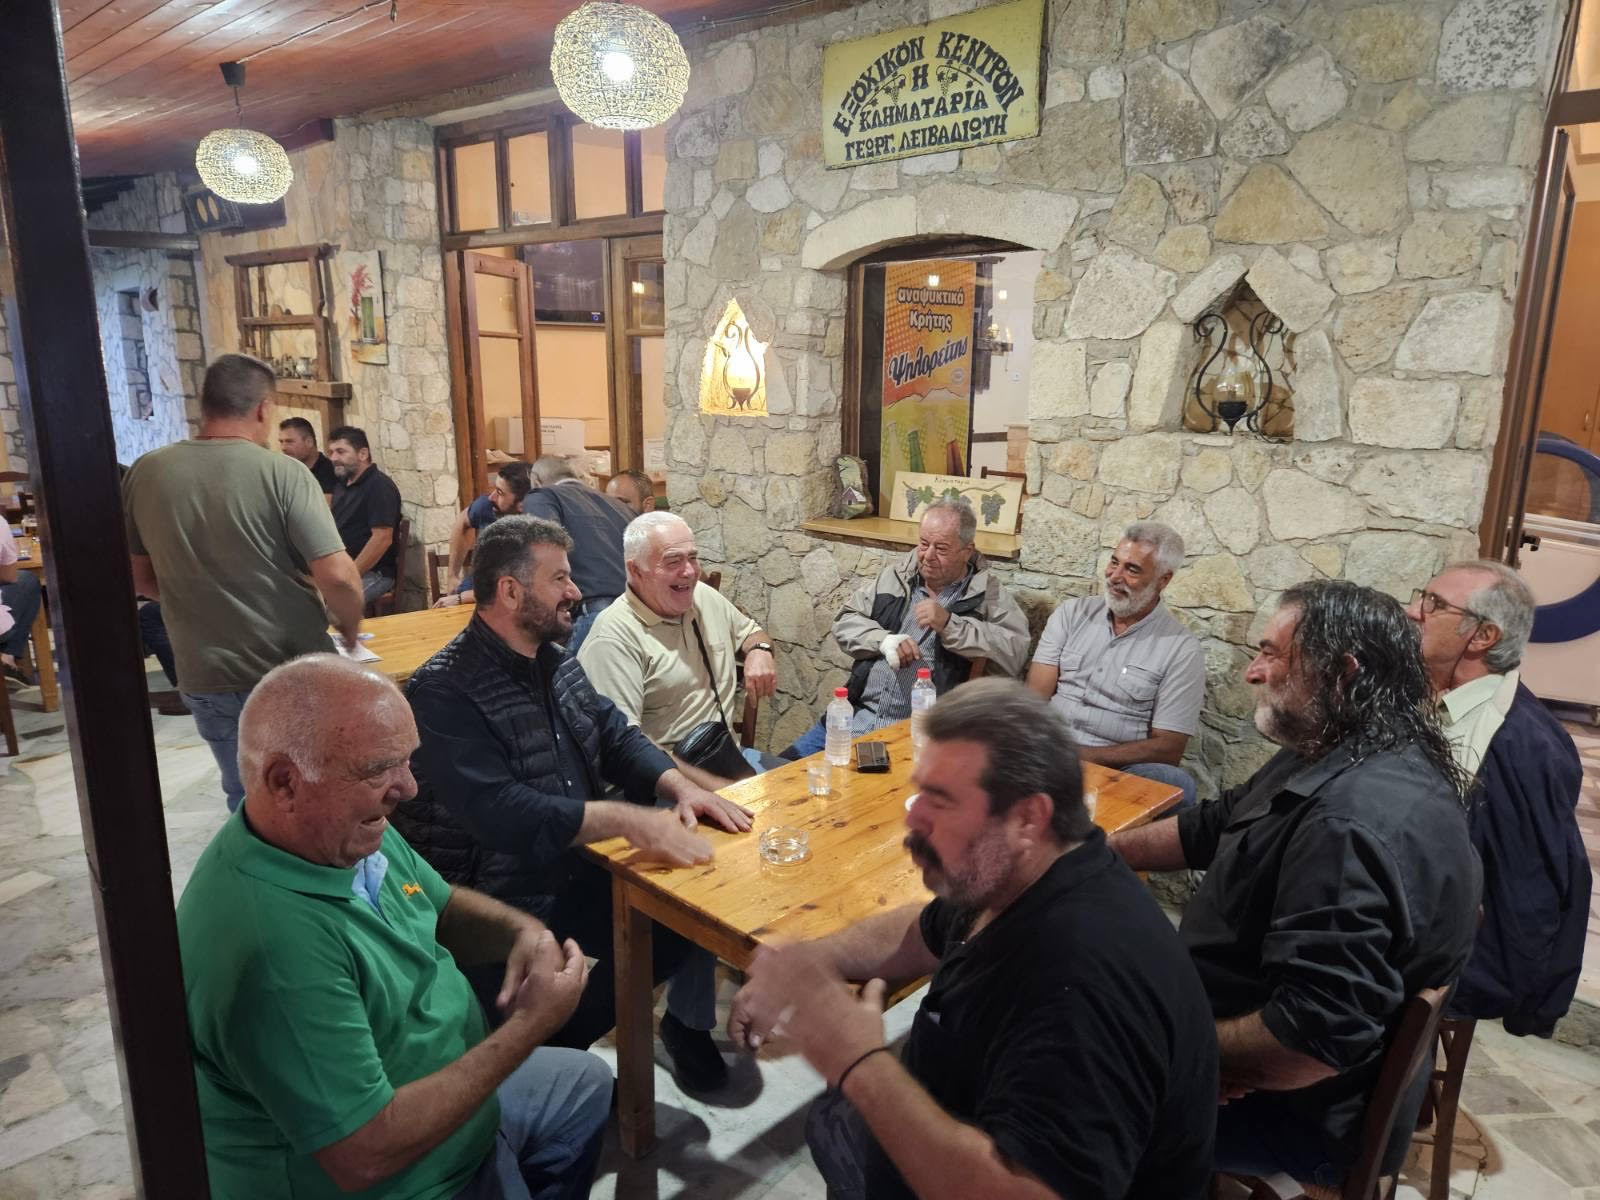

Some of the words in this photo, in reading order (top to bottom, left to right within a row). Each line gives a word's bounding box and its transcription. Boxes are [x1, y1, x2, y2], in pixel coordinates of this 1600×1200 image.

[833, 36, 926, 137] ΕΞΟΧΙΚΟΝ
[935, 31, 1024, 112] ΚΕΝΤΡΟΝ
[911, 63, 929, 91] Η
[859, 89, 988, 132] ΚΛΗΜΑΤΑΡΙΑ
[845, 135, 896, 160] ΓΕΩΡΓ.
[900, 114, 1008, 150] ΛΕΙΒΑΔΙΩΤΗ
[897, 286, 965, 308] αναψυκτικά
[909, 309, 953, 333] Κρήτης
[889, 335, 969, 387] Ψηλορείτης
